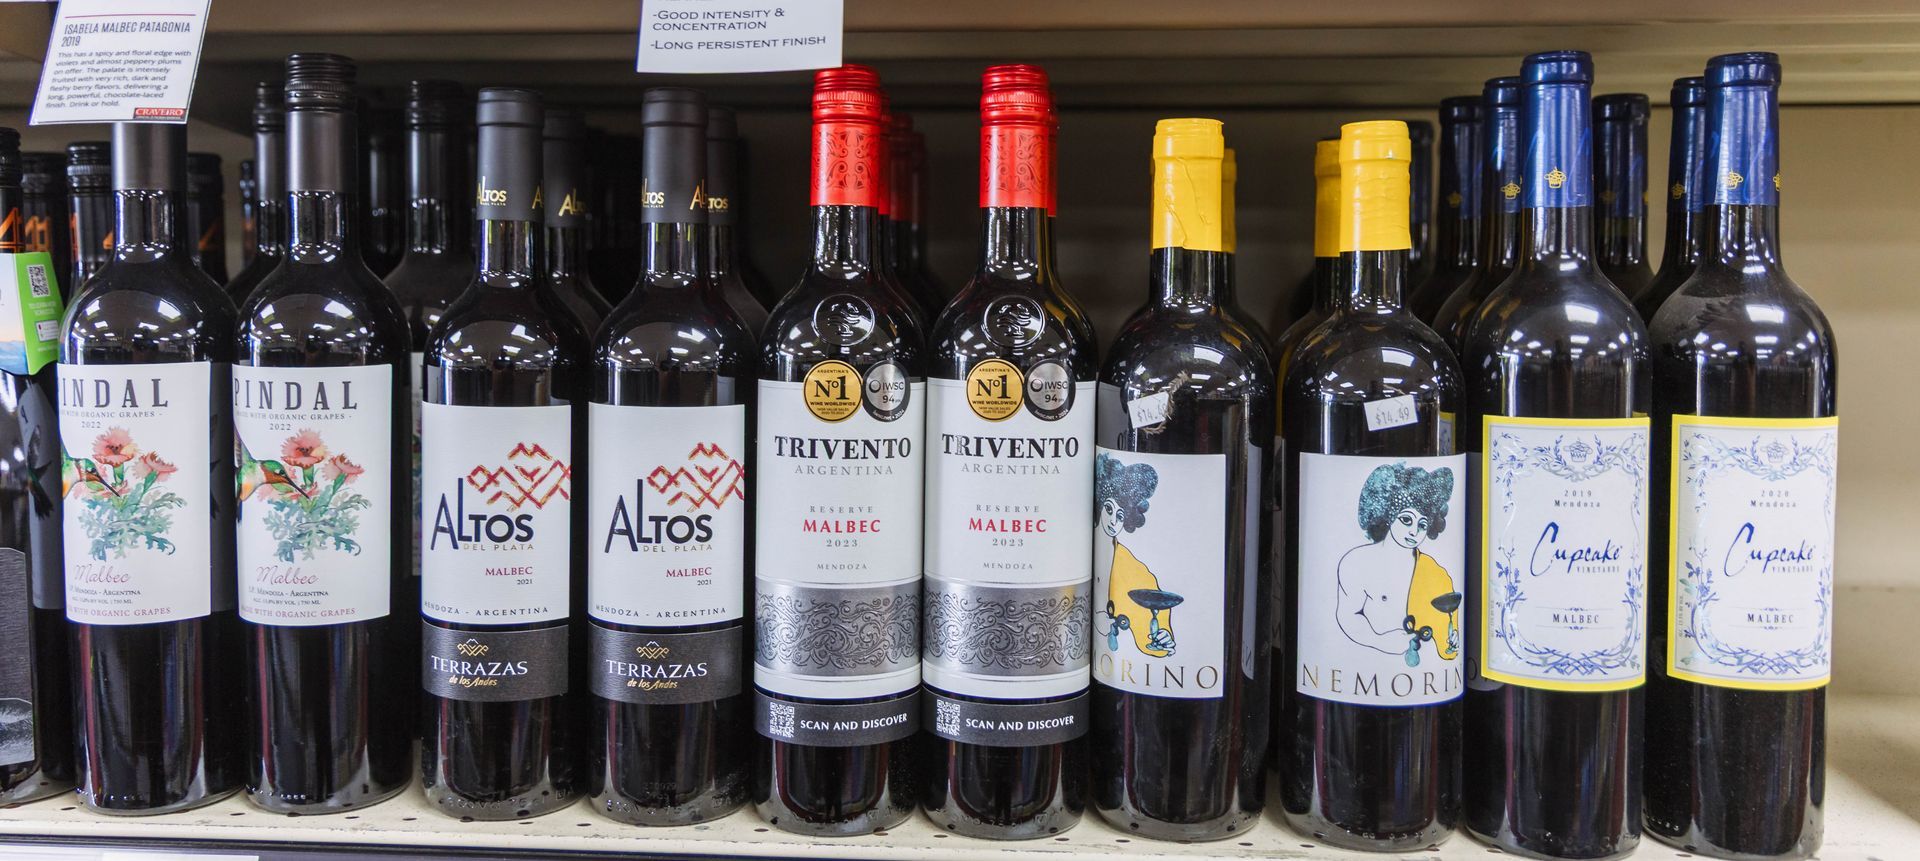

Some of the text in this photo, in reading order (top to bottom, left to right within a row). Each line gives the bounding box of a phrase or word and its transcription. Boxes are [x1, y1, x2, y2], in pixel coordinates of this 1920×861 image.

[703, 10, 771, 20] INTENSITY
[774, 8, 785, 17] &
[64, 22, 191, 35] ISABELA MALBEC PATAGONIA
[652, 21, 767, 31] CONCENTRATION
[61, 36, 81, 47] 2019
[650, 36, 826, 50] -LONG PERSISTENT FINISH
[154, 50, 173, 58] edge
[135, 108, 184, 116] CRAVEIRO
[882, 382, 904, 391] IWSC
[1044, 381, 1069, 390] IWSC
[234, 378, 358, 411] PINDAL
[882, 394, 895, 404] 94
[1045, 394, 1058, 403] 94
[81, 421, 102, 429] 2022
[774, 436, 912, 460] TRIVENTO
[942, 434, 1080, 459] TRIVENTO
[794, 464, 893, 476] ARGENTINA
[962, 463, 1061, 475] ARGENTINA
[1761, 490, 1790, 498] 2020
[976, 504, 1040, 513] RESERVE
[1554, 500, 1601, 508] Mendoza
[1750, 500, 1797, 508] Mendoza
[810, 506, 873, 514] RESERVE
[803, 519, 881, 534] MALBEC
[968, 518, 1047, 533] MALBEC
[494, 543, 534, 551] PLATA
[826, 540, 859, 548] 2023
[992, 538, 1025, 547] 2023
[643, 544, 713, 553] DEL PLATA
[1530, 522, 1621, 577] Cupcake
[1724, 522, 1814, 577] Cupcake
[485, 566, 533, 576] MALBEC
[983, 562, 1034, 570] MENDOZA
[74, 564, 131, 584] Malbec
[256, 565, 320, 585] Malbec
[666, 567, 712, 578] MALBEC
[102, 588, 141, 596] ARGENTINA
[91, 608, 131, 617] ORGANIC
[134, 607, 172, 617] GRAPES
[255, 608, 273, 617] WITH
[276, 609, 318, 618] ORGANIC
[320, 608, 356, 617] GRAPES
[424, 600, 549, 616] MENDOZA ARGENTINA
[596, 604, 727, 618] MENDOZA ARGENTINA
[1552, 613, 1600, 624] MALBEC
[1747, 613, 1794, 624] MALBEC
[431, 655, 528, 676] TERRAZAS
[606, 660, 708, 679] TERRAZAS
[1094, 653, 1218, 690] ORINO
[449, 675, 498, 688] de los Andes
[627, 678, 678, 691] de los Andes
[800, 712, 908, 731] SCAN AND DISCOVER
[966, 715, 1075, 731] SCAN AND DISCOVER
